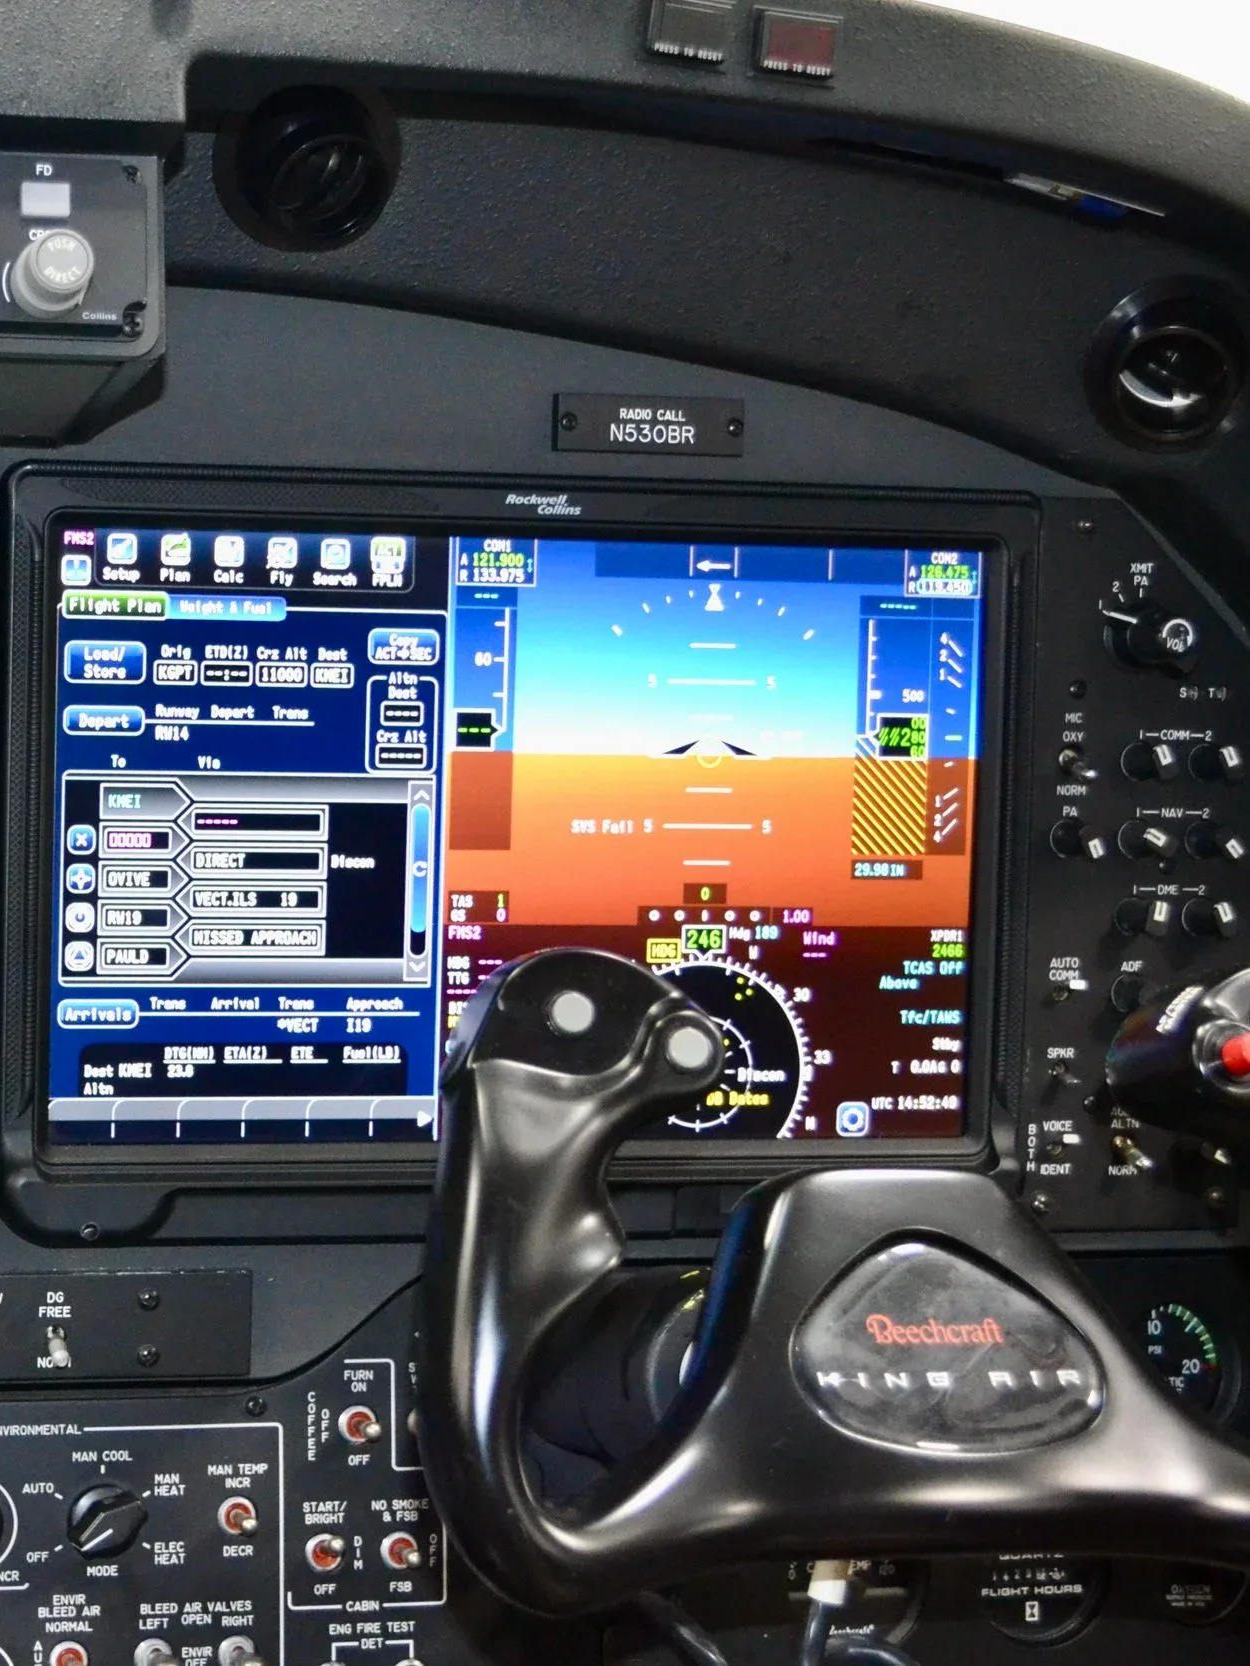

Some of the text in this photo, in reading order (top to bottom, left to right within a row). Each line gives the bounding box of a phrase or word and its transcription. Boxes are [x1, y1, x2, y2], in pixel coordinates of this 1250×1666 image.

[684, 46, 693, 57] TO
[698, 48, 723, 61] RESET
[36, 164, 52, 176] FD
[44, 265, 82, 284] DIRECT
[82, 312, 117, 320] Collins
[619, 408, 686, 422] RADIO CALL
[610, 424, 695, 444] N530BR
[505, 494, 567, 505] Rockwell
[537, 503, 581, 515] Collins
[1130, 563, 1154, 574] XMIT
[102, 568, 190, 583] Setup Plan
[69, 598, 162, 614] Flight Plan
[158, 665, 192, 679] KGPT
[1065, 713, 1083, 723] MIC
[1057, 786, 1086, 795] NORM
[195, 854, 246, 868] DIRECT
[193, 931, 317, 946] MISSED APPROACH
[686, 931, 722, 948] 246
[903, 962, 966, 975] TCAS Off
[1050, 958, 1079, 968] AUTO
[1121, 961, 1142, 971] ADF
[64, 1007, 131, 1022] Arrivals
[1047, 1048, 1074, 1058] SPKR
[1043, 1121, 1072, 1131] VOICE
[1040, 1164, 1070, 1175] IDENT
[38, 1306, 71, 1318] FREE
[865, 1312, 1005, 1346] Beechcraft
[1182, 1359, 1200, 1373] 20
[344, 1370, 374, 1380] FURN
[815, 1369, 1081, 1388] KING AIR
[72, 1451, 132, 1462] MAN COOL
[208, 1464, 268, 1475] MAN TEMP
[22, 1483, 54, 1494] AUTO
[225, 1478, 250, 1488] INCR
[154, 1485, 186, 1496] HEAT
[303, 1502, 347, 1513] START/
[305, 1513, 345, 1524] BRIGHT
[154, 1542, 185, 1553] ELEC
[223, 1546, 253, 1556] DECR
[87, 1566, 118, 1576] MODE
[981, 1584, 1082, 1597] FLIGHT HOURS
[53, 1595, 85, 1605] ENVIR
[140, 1601, 252, 1615] BLEED AIR VALVES
[346, 1601, 380, 1611] CABIN
[38, 1606, 100, 1618] BLEED AIR
[46, 1621, 93, 1632] NORMAL
[139, 1618, 168, 1629] LEFT
[221, 1616, 254, 1626] RIGHT
[329, 1621, 415, 1635] ENG FIRE TEST
